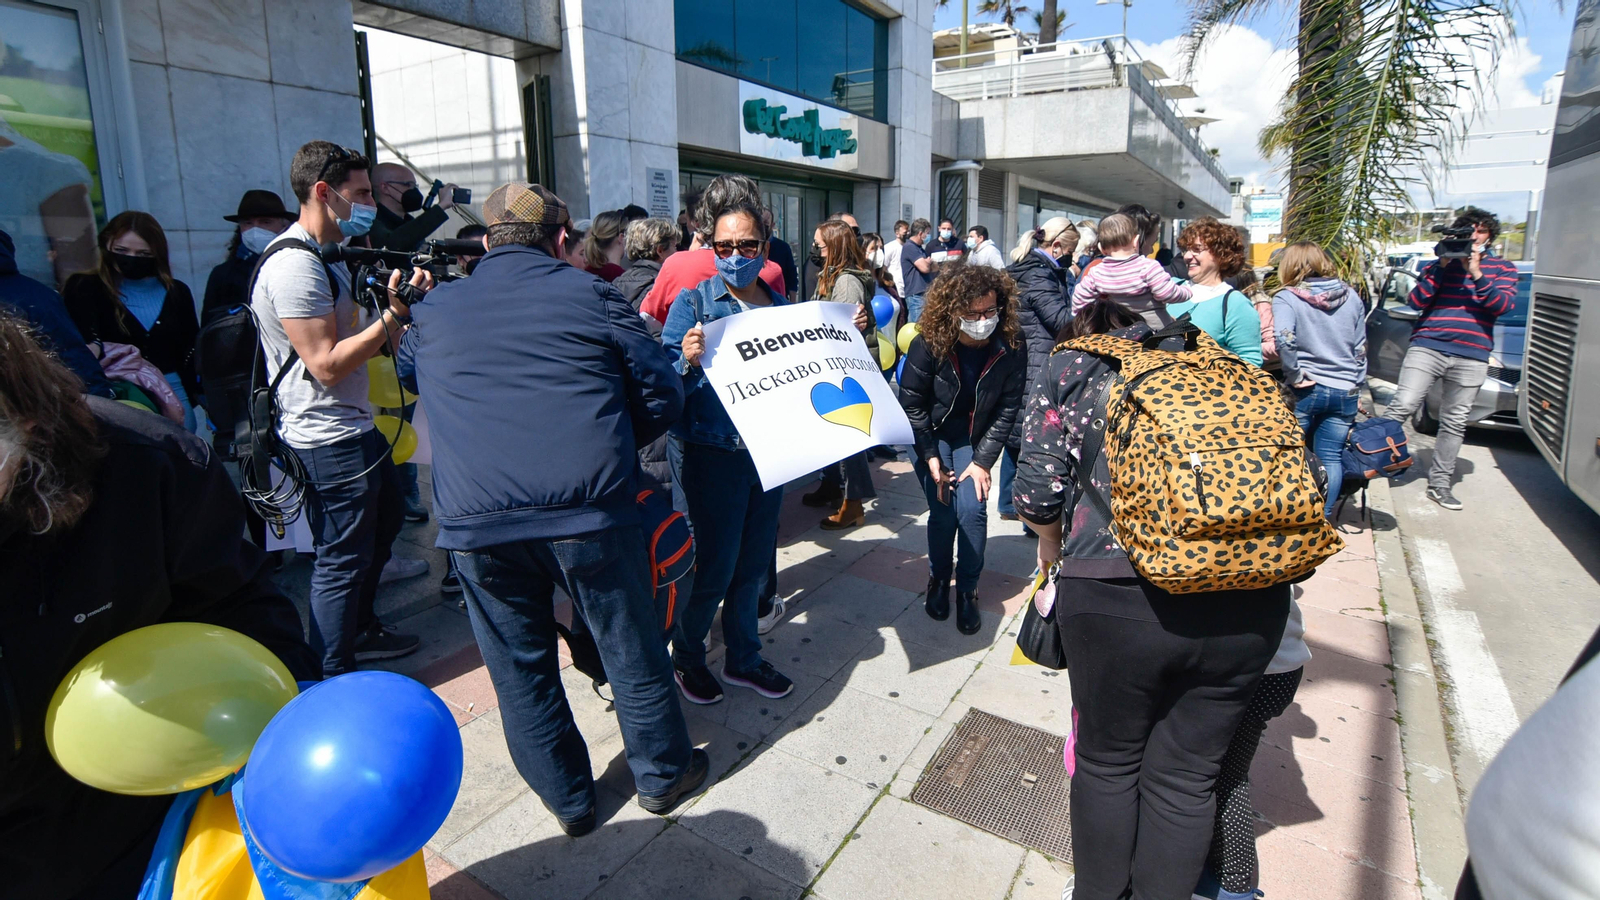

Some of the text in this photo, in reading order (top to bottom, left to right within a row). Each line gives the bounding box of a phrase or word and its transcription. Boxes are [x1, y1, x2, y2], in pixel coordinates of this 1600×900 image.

[735, 323, 852, 362] Bienvenidos
[725, 356, 880, 404] Ласкаво просимо
